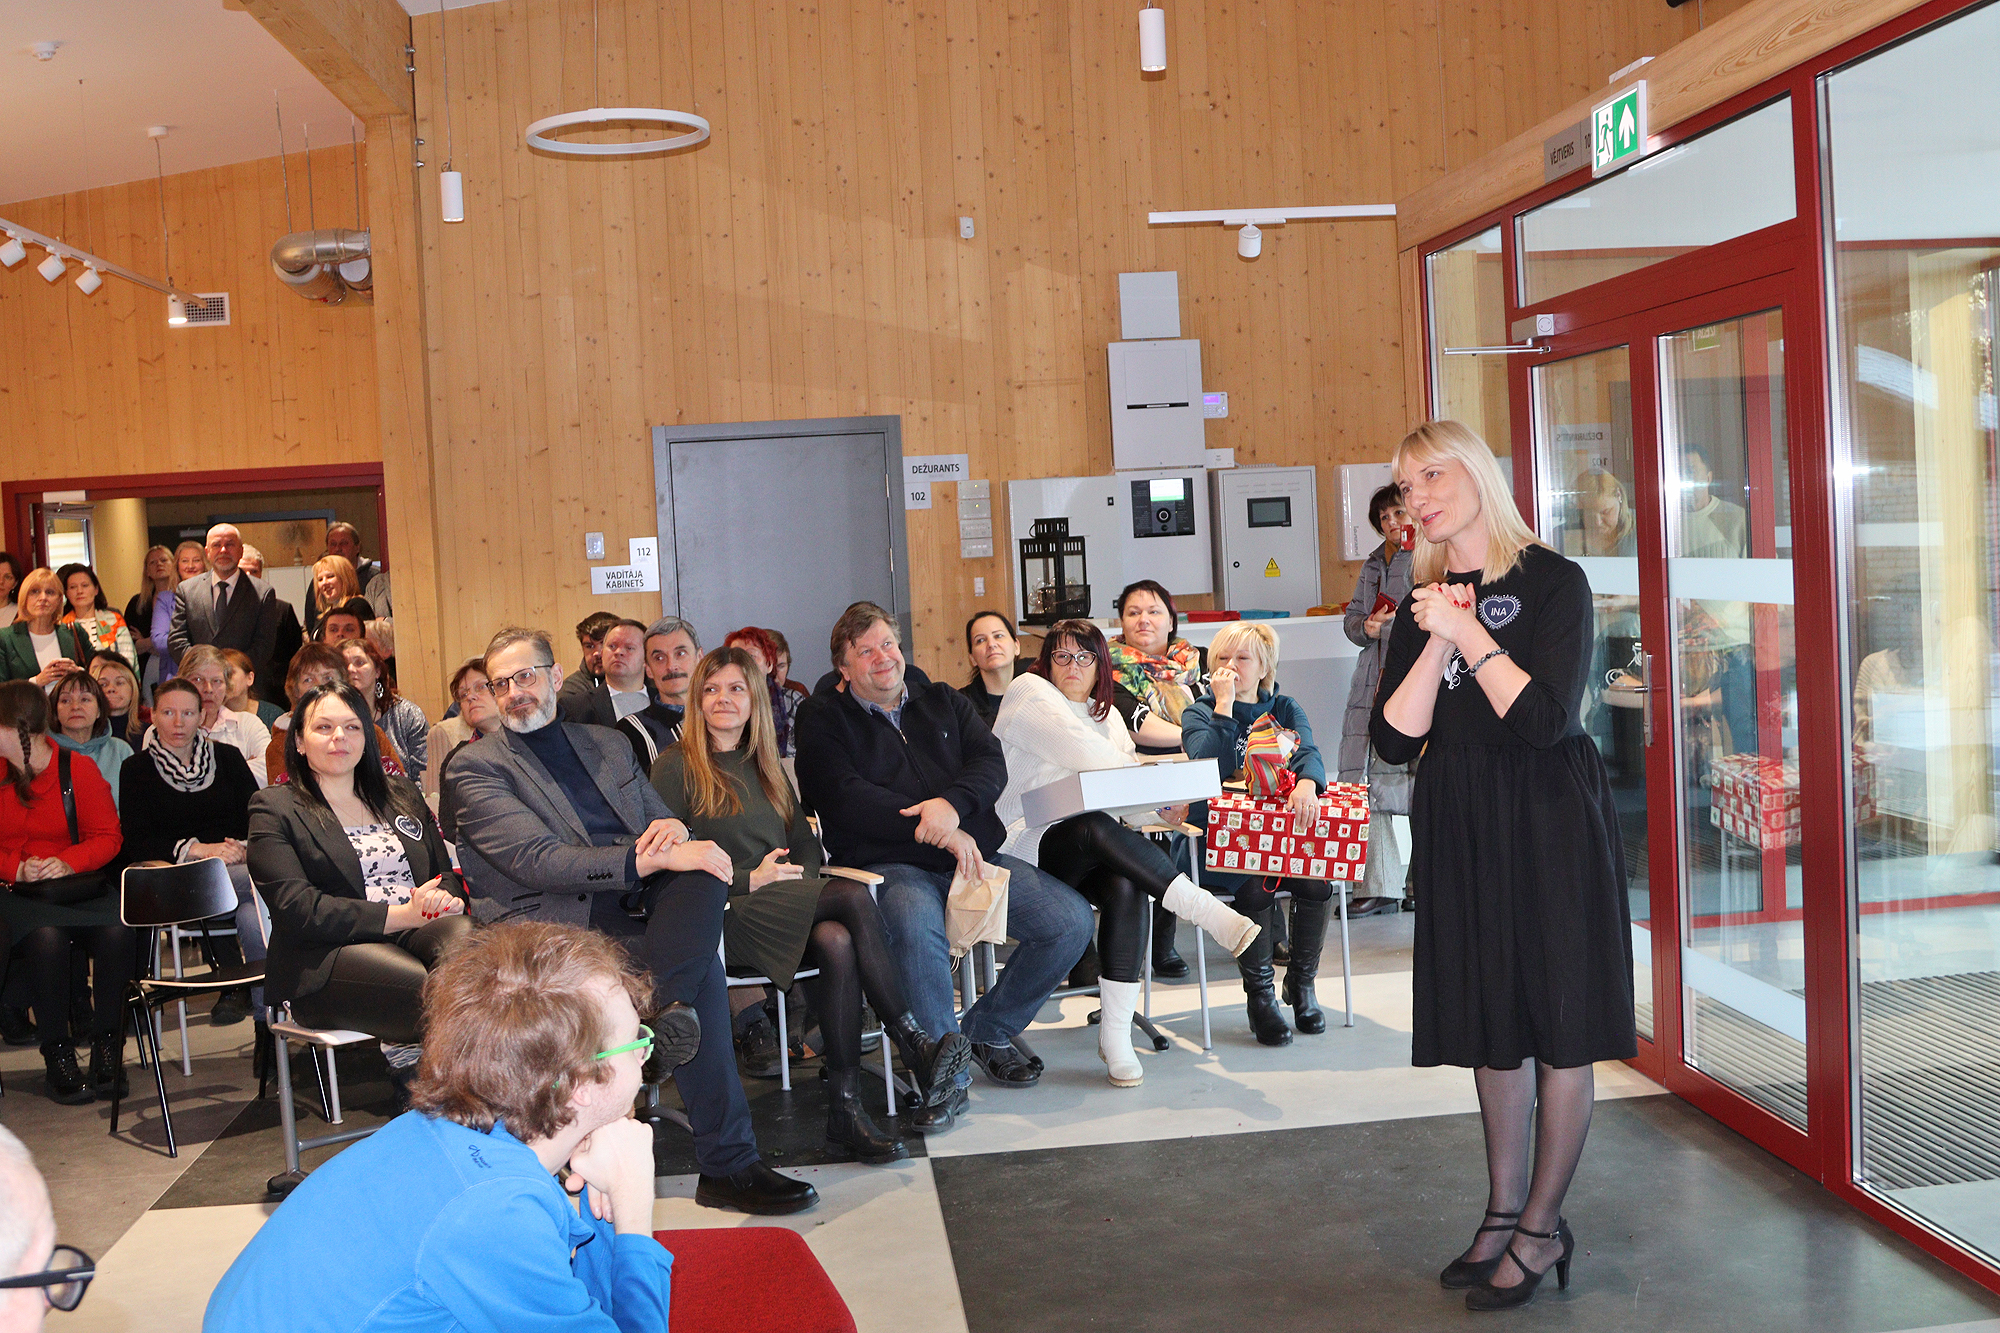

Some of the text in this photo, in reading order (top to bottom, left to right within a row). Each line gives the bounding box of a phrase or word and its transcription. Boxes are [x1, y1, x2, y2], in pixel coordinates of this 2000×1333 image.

[1584, 133, 1592, 149] 10
[911, 462, 960, 475] DEŽURANTS
[910, 491, 926, 502] 102
[636, 547, 651, 557] 112
[605, 569, 644, 580] VADĪTĀJA
[605, 578, 645, 589] KABINETS
[1490, 606, 1507, 616] INA
